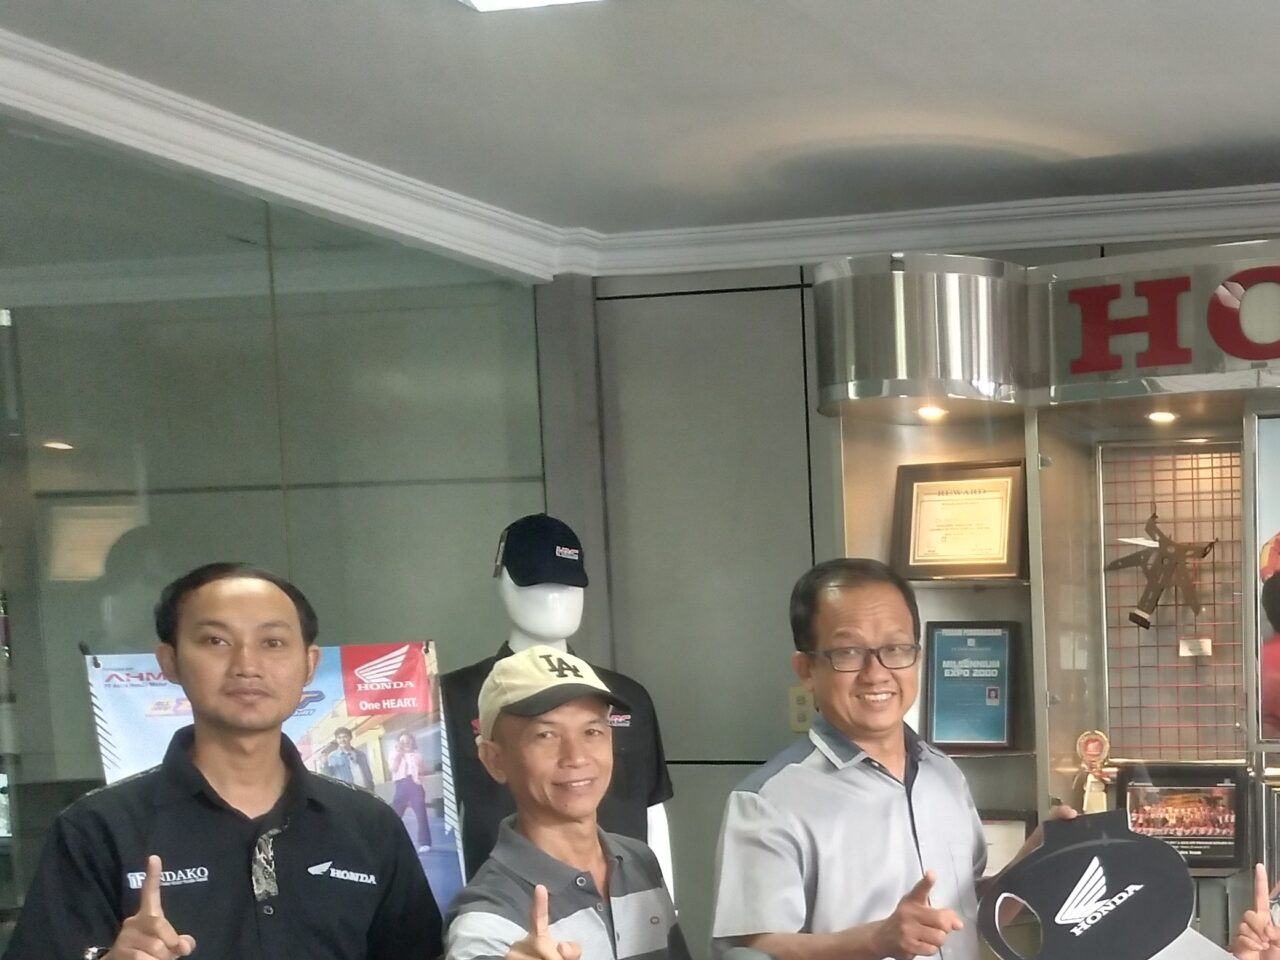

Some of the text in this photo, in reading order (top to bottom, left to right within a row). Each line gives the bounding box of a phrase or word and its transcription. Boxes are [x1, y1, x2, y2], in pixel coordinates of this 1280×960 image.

[539, 654, 584, 678] LA
[356, 681, 415, 691] HONDA
[359, 699, 380, 711] One
[329, 867, 377, 885] HONDA
[1069, 883, 1145, 937] HONDA
